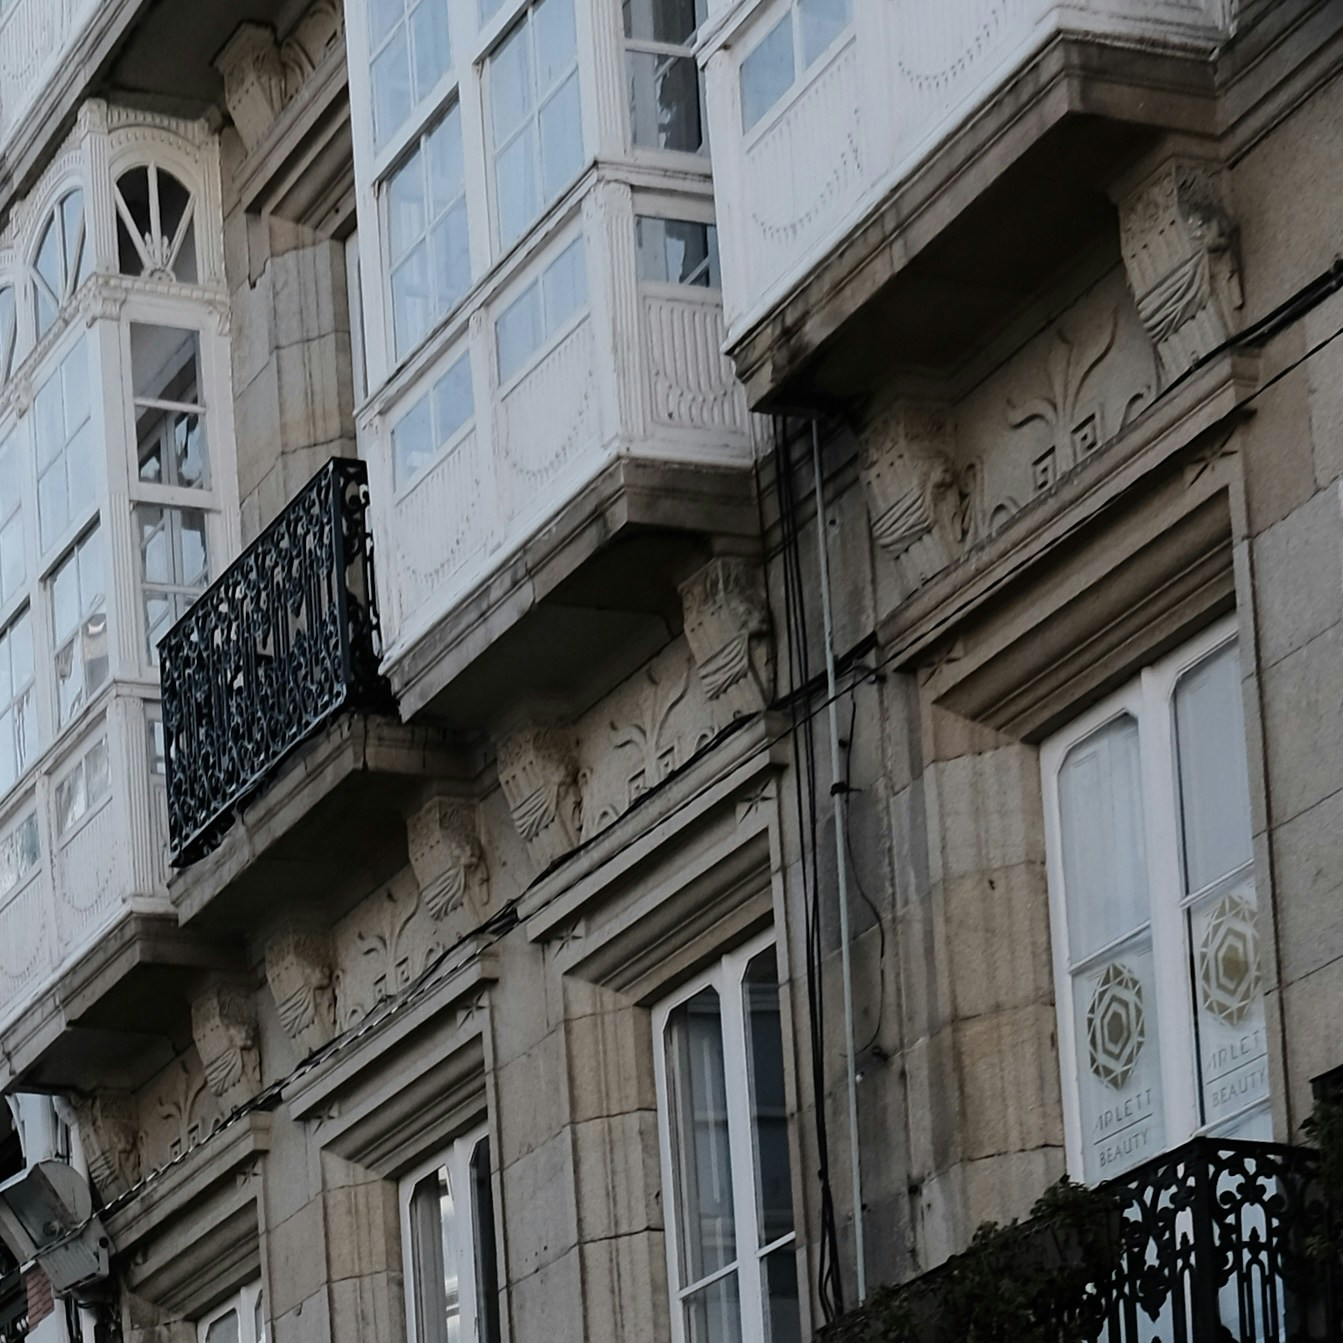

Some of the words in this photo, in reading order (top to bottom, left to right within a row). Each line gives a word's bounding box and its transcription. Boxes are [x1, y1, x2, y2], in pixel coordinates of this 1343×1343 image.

[1204, 1029, 1263, 1075] ARLET
[1212, 1066, 1266, 1107] BEAUTY
[1099, 1127, 1149, 1168] BEAUTY
